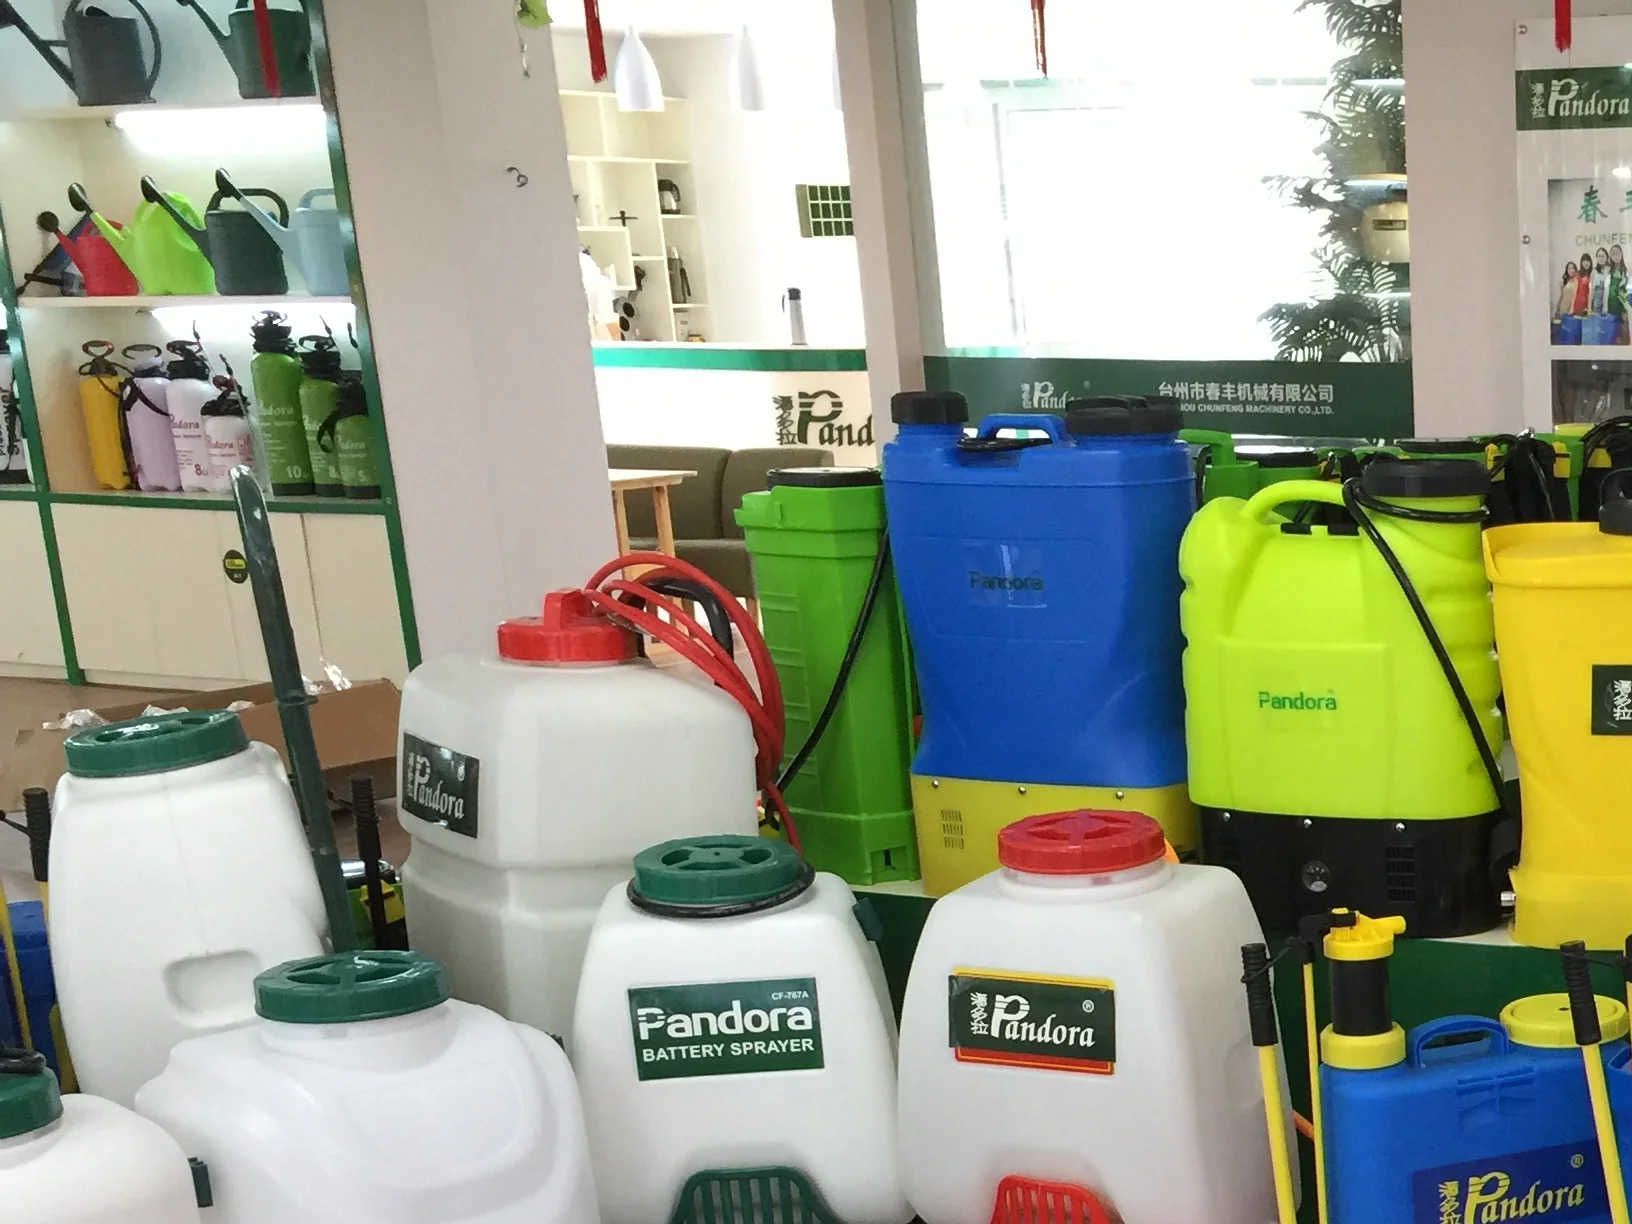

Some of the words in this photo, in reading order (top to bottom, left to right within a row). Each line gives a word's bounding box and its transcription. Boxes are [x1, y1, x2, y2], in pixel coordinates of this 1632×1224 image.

[1548, 78, 1630, 117] Pandora
[1032, 381, 1074, 409] Pand
[1158, 381, 1335, 403] 台州市春丰机械有限公司
[1198, 404, 1244, 413] CHUNFENG
[1246, 405, 1296, 415] MACHINERY
[969, 571, 1044, 591] Pandora
[1259, 691, 1337, 710] Pandora
[1613, 680, 1632, 721] 潘多拉
[413, 754, 465, 819] Pandora
[637, 1000, 813, 1040] Pandora
[969, 991, 989, 1035] 潘多拉
[990, 994, 1096, 1048] Pandora
[642, 1043, 725, 1063] BATTERY
[729, 1038, 815, 1057] SPRAYER
